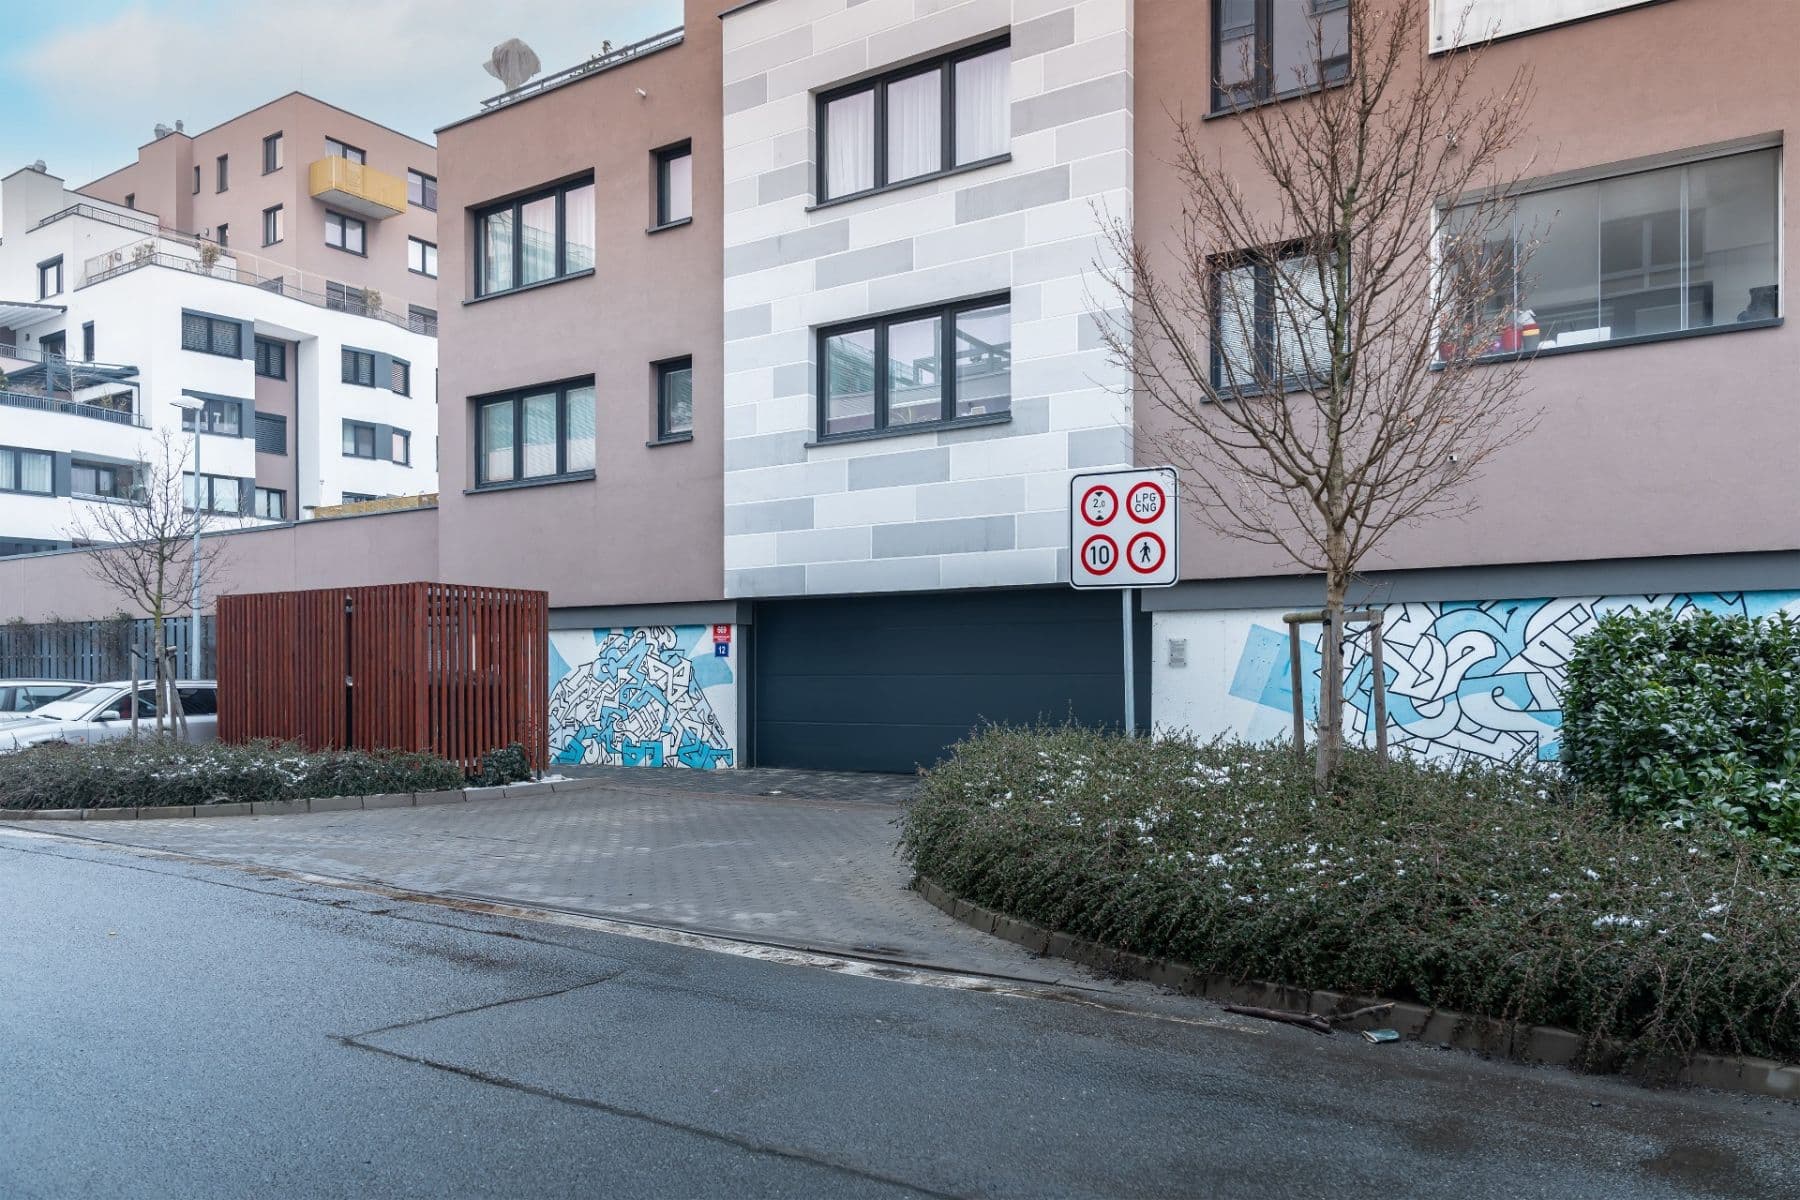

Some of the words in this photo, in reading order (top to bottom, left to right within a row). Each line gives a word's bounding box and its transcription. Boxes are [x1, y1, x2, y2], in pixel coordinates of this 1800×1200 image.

[1135, 493, 1156, 503] LPG
[1135, 503, 1157, 513] CNG
[1090, 545, 1110, 565] 10
[718, 645, 726, 655] 12
